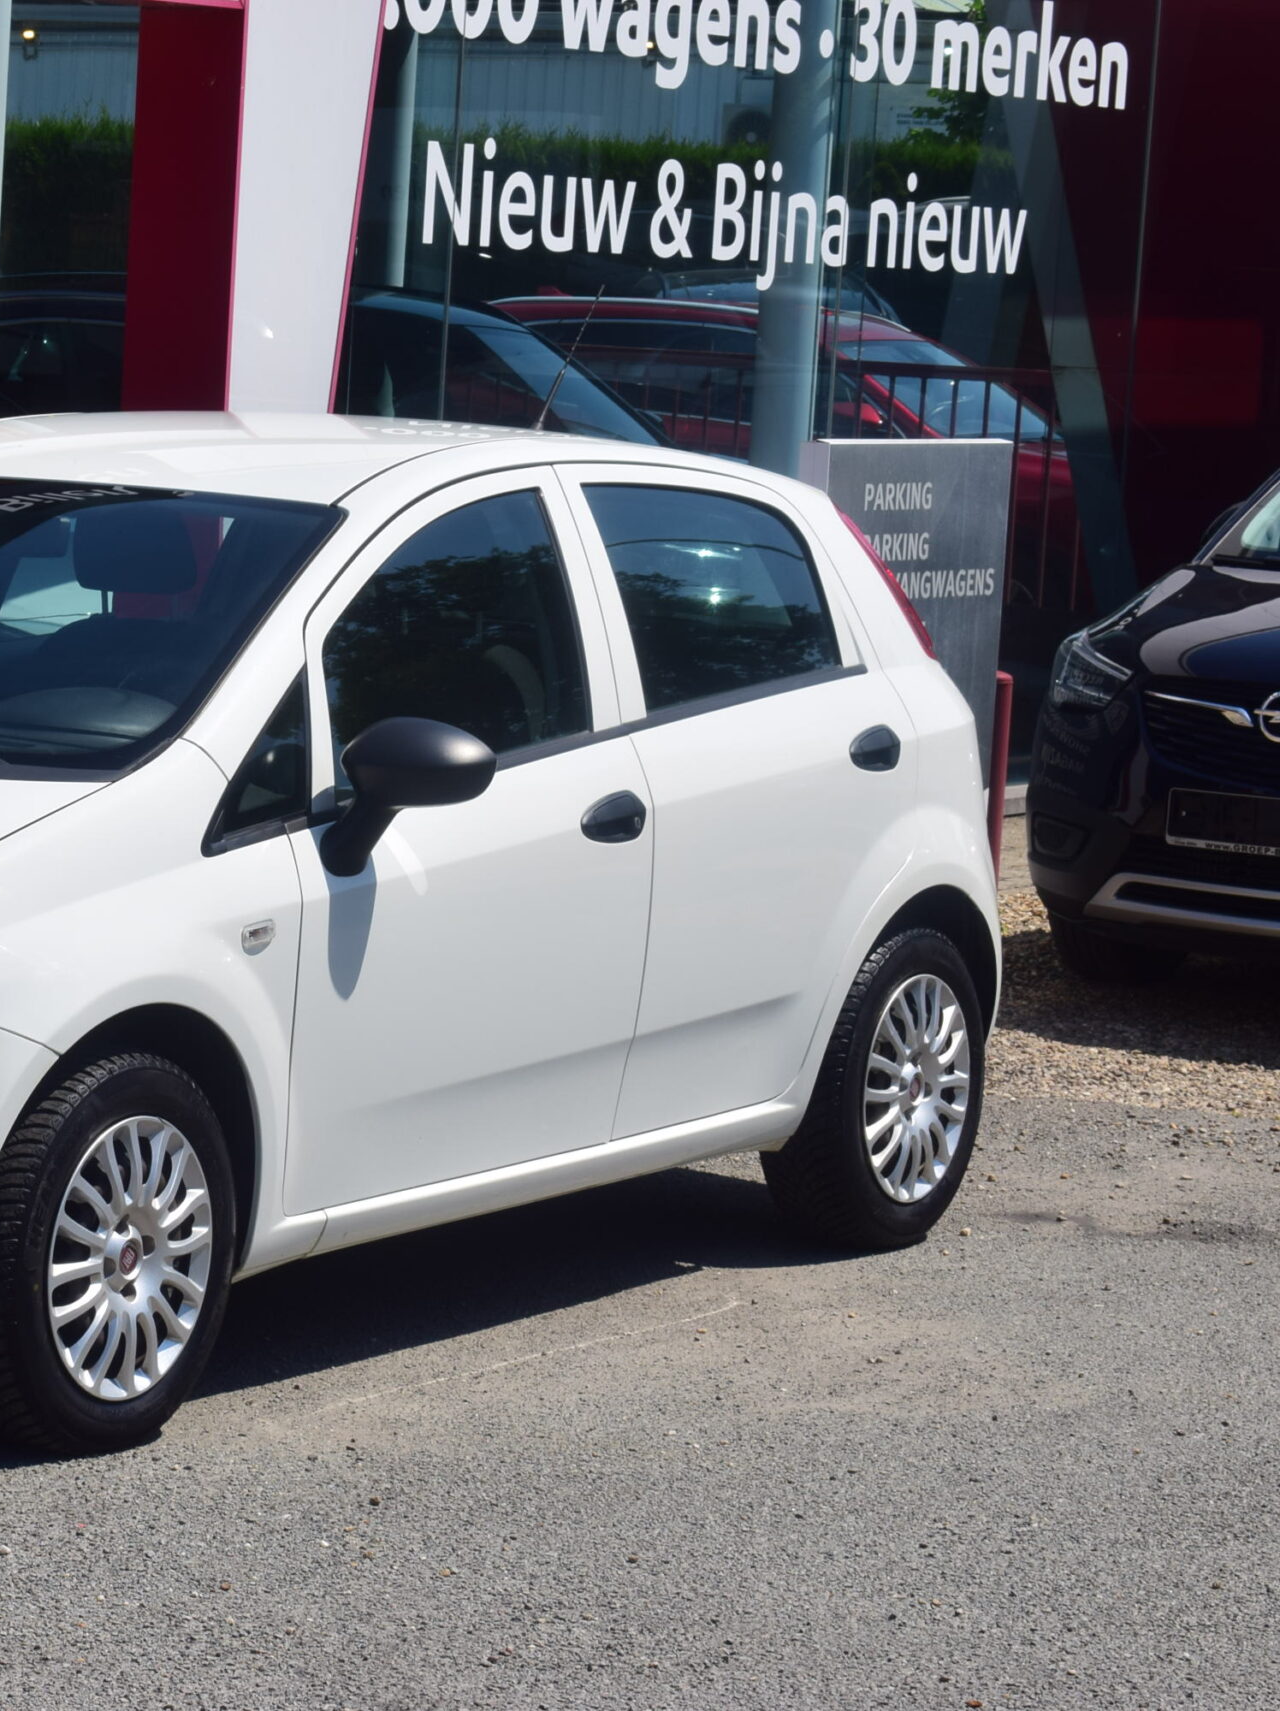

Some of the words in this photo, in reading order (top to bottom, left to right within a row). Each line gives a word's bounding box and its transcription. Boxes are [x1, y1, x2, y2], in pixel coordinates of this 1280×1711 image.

[559, 0, 802, 90] wagens
[850, 0, 918, 86] 30
[930, 0, 1128, 110] merken
[422, 137, 637, 255] Nieuw
[650, 158, 693, 259] &
[711, 160, 850, 292] Bijna
[866, 172, 1028, 276] nieuw
[863, 481, 933, 512] PARKING
